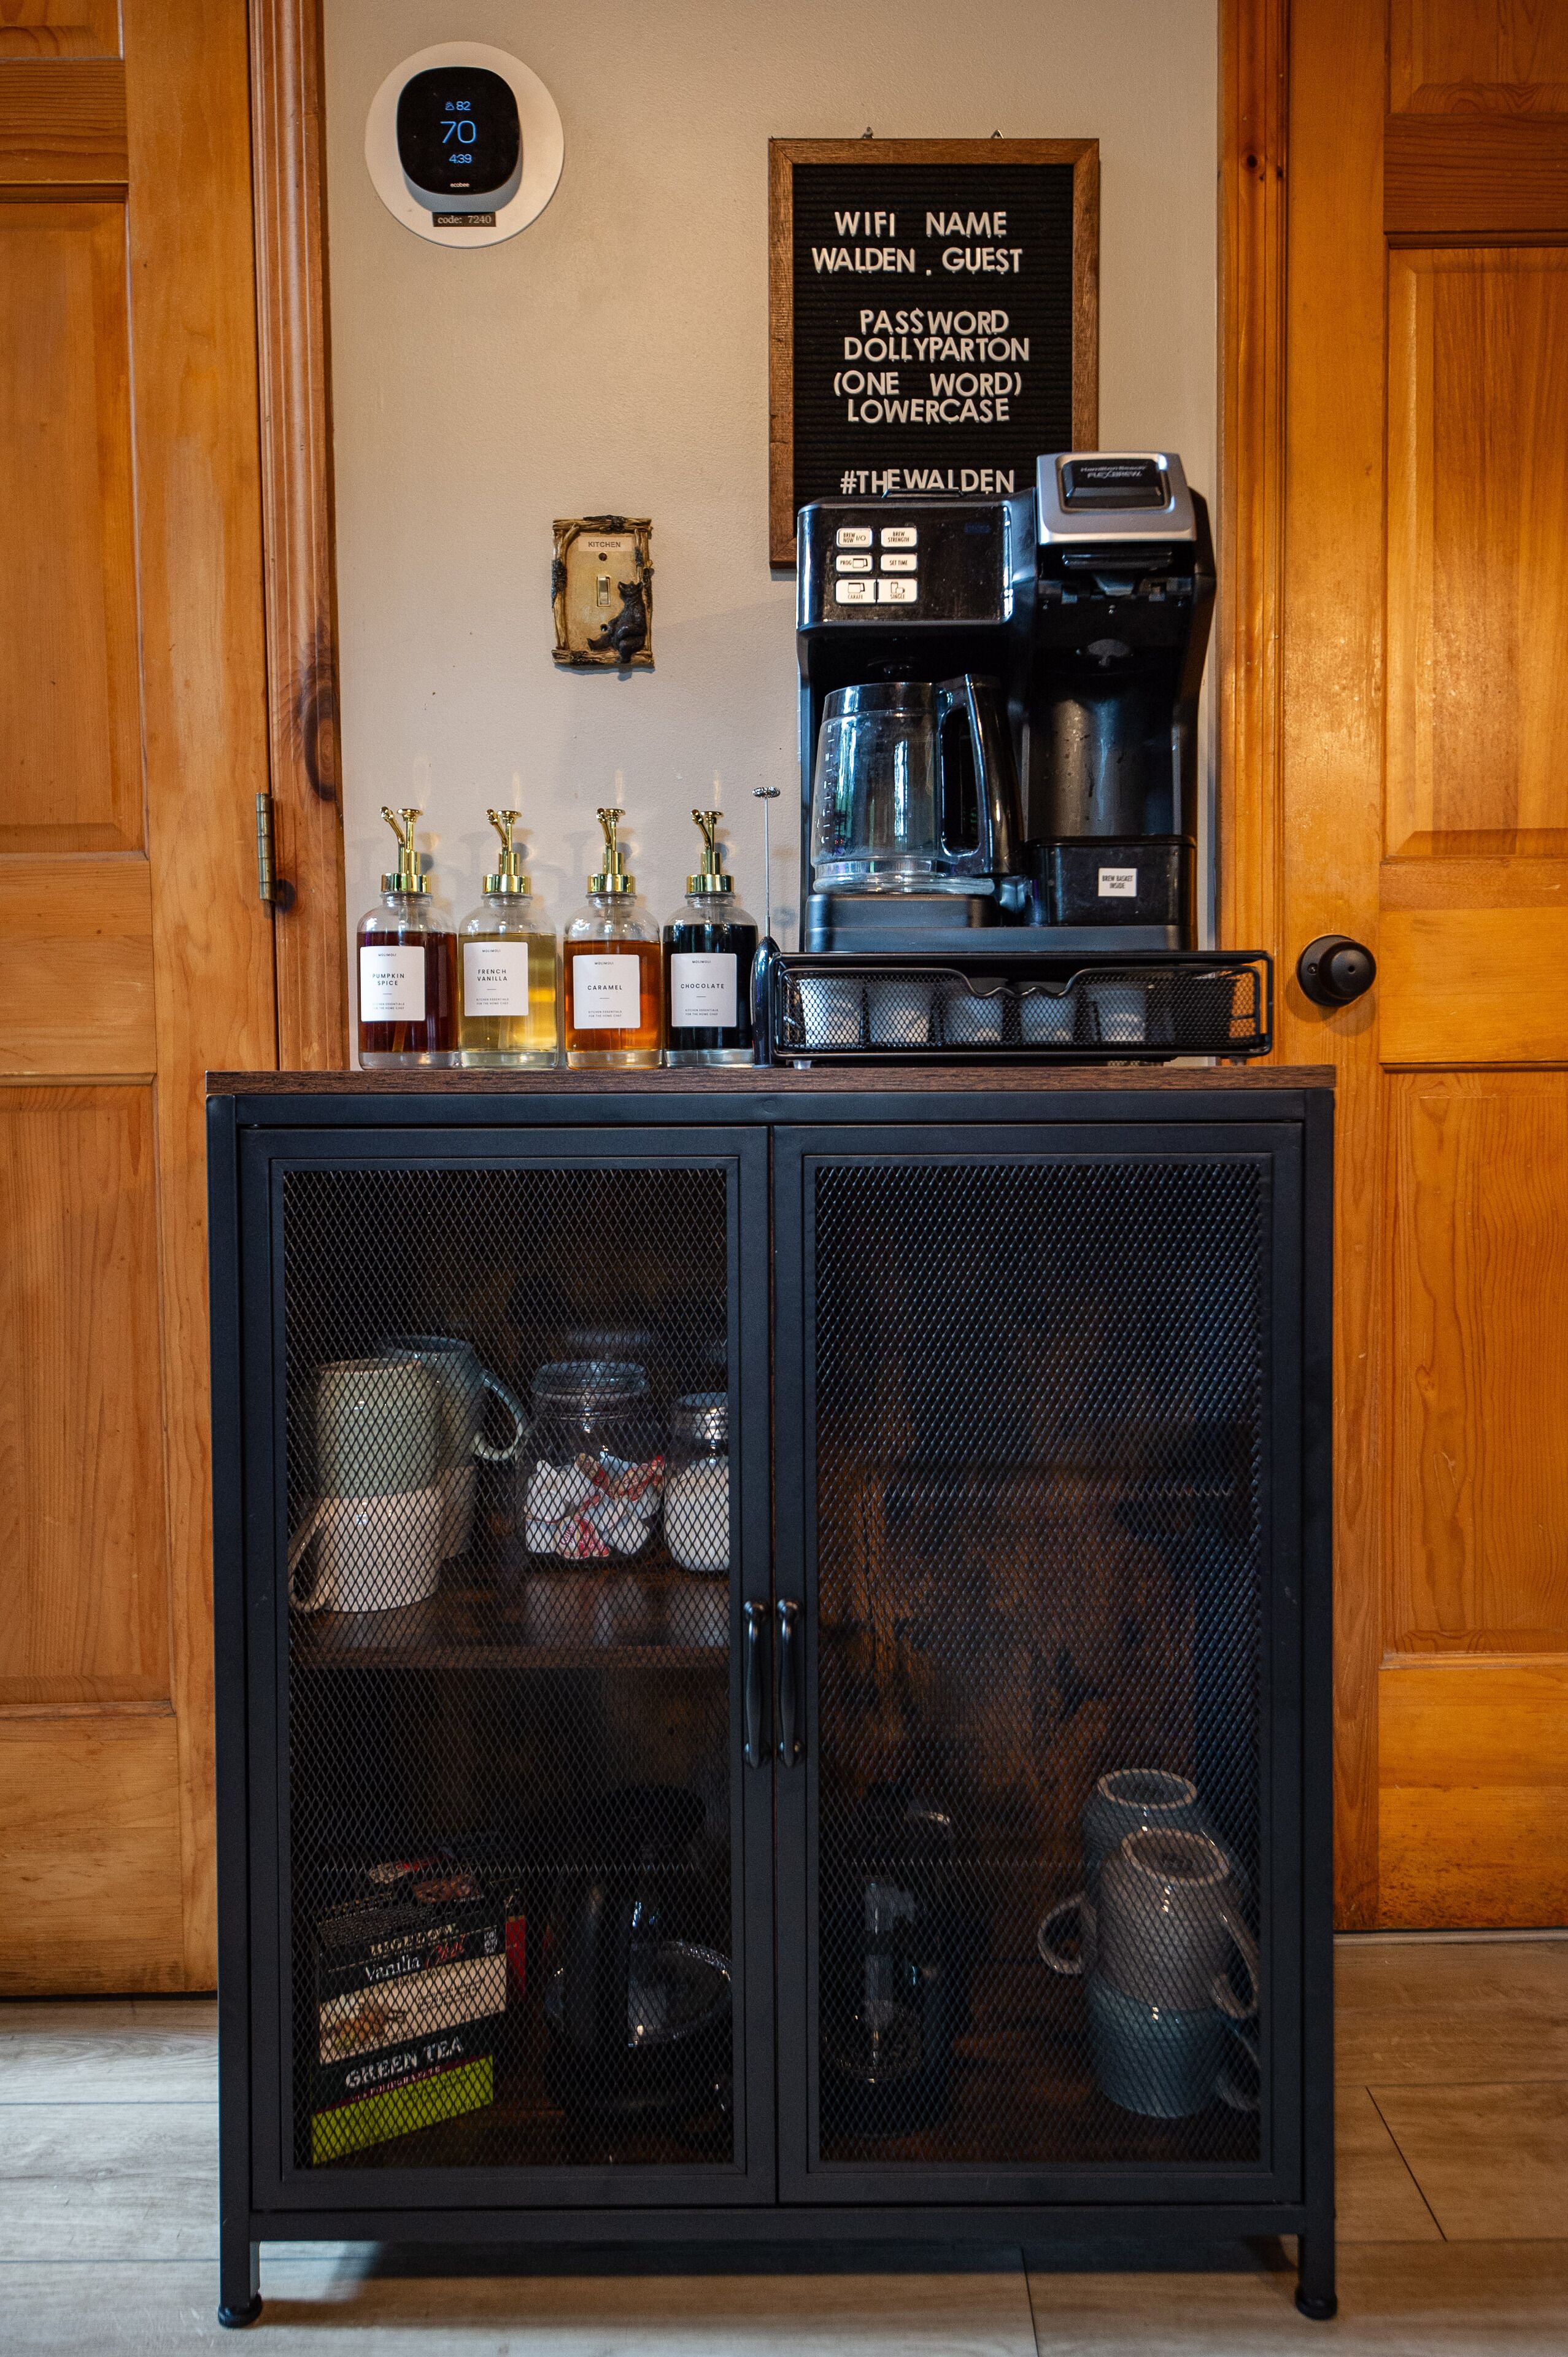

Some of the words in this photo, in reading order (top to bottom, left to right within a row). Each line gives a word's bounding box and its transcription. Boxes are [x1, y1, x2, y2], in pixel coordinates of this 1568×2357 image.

[456, 101, 471, 110] 82
[440, 120, 476, 144] 70
[835, 212, 895, 238] WIFI
[926, 212, 1006, 238] NAME
[811, 247, 915, 274] WALDEN
[942, 247, 1022, 274] GUEST
[860, 308, 1009, 335] PASSWORD
[844, 337, 1029, 362] DOLLYPARTON
[833, 370, 900, 396] (ONE
[930, 372, 1021, 397] WORD)
[848, 398, 1010, 424] LOWERCASE
[840, 469, 1014, 494] #THEWALDEN
[365, 1954, 420, 1982] Vanilla
[346, 2049, 417, 2088] GREEN
[424, 2035, 464, 2062] TEA
